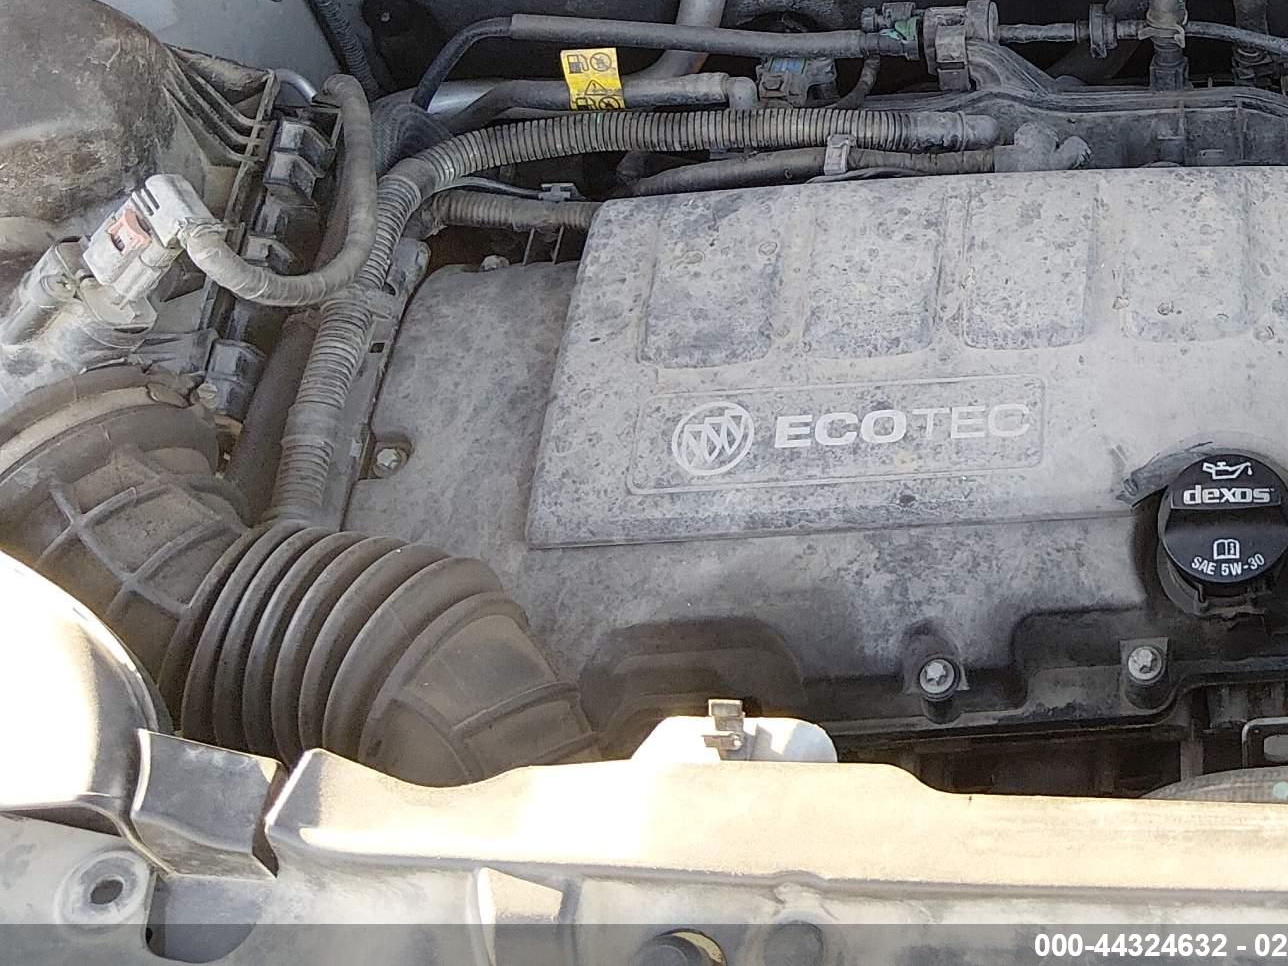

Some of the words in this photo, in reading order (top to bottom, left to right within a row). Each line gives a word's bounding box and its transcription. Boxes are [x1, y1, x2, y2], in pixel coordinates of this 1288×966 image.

[774, 403, 1032, 448] ECOTEC
[1183, 484, 1271, 505] dexos
[1191, 556, 1217, 575] SAE
[1221, 553, 1265, 576] 5W-30
